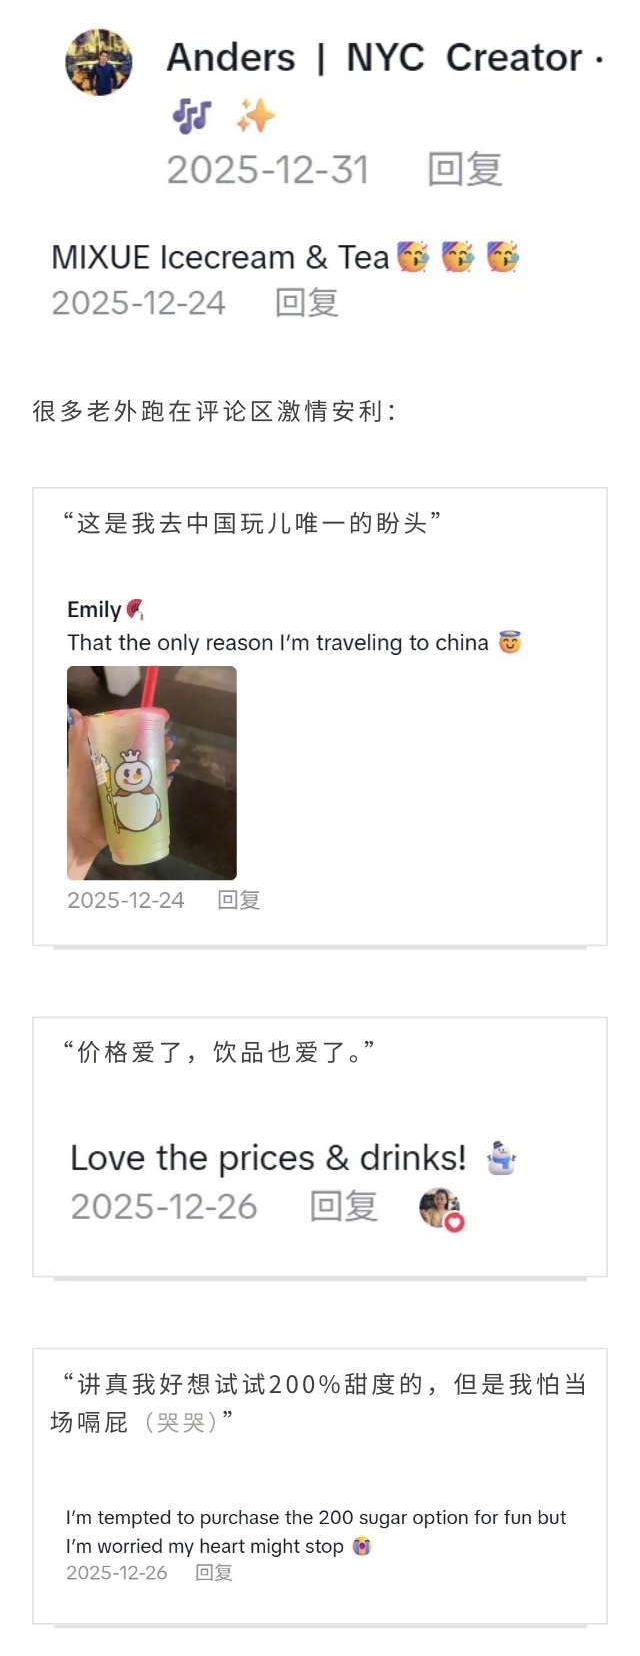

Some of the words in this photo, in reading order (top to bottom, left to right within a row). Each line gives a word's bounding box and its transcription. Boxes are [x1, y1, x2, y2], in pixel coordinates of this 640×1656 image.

[167, 41, 295, 71] Anders
[348, 43, 424, 71] NYC
[447, 43, 582, 71] Creator
[68, 600, 121, 622] Emily
[67, 634, 112, 650] That
[118, 634, 150, 650] the
[158, 634, 199, 655] only
[207, 638, 272, 650] reason
[316, 634, 401, 655] traveling
[409, 635, 429, 650] to
[436, 634, 488, 650] china
[68, 892, 184, 909] 2025-12-24
[219, 890, 260, 910] 回复
[72, 1144, 144, 1170] Love
[156, 1143, 207, 1170] the
[220, 1143, 314, 1178] prices
[326, 1144, 349, 1170] &
[361, 1143, 465, 1170] drinks!
[98, 1510, 170, 1528] tempted
[177, 1511, 194, 1525] to
[201, 1510, 279, 1528] purchase
[285, 1510, 313, 1525] the
[319, 1510, 353, 1525] 200
[360, 1514, 407, 1528] sugar
[413, 1510, 468, 1528] option
[474, 1510, 498, 1525] for
[504, 1510, 531, 1525] fun
[539, 1510, 566, 1525] but
